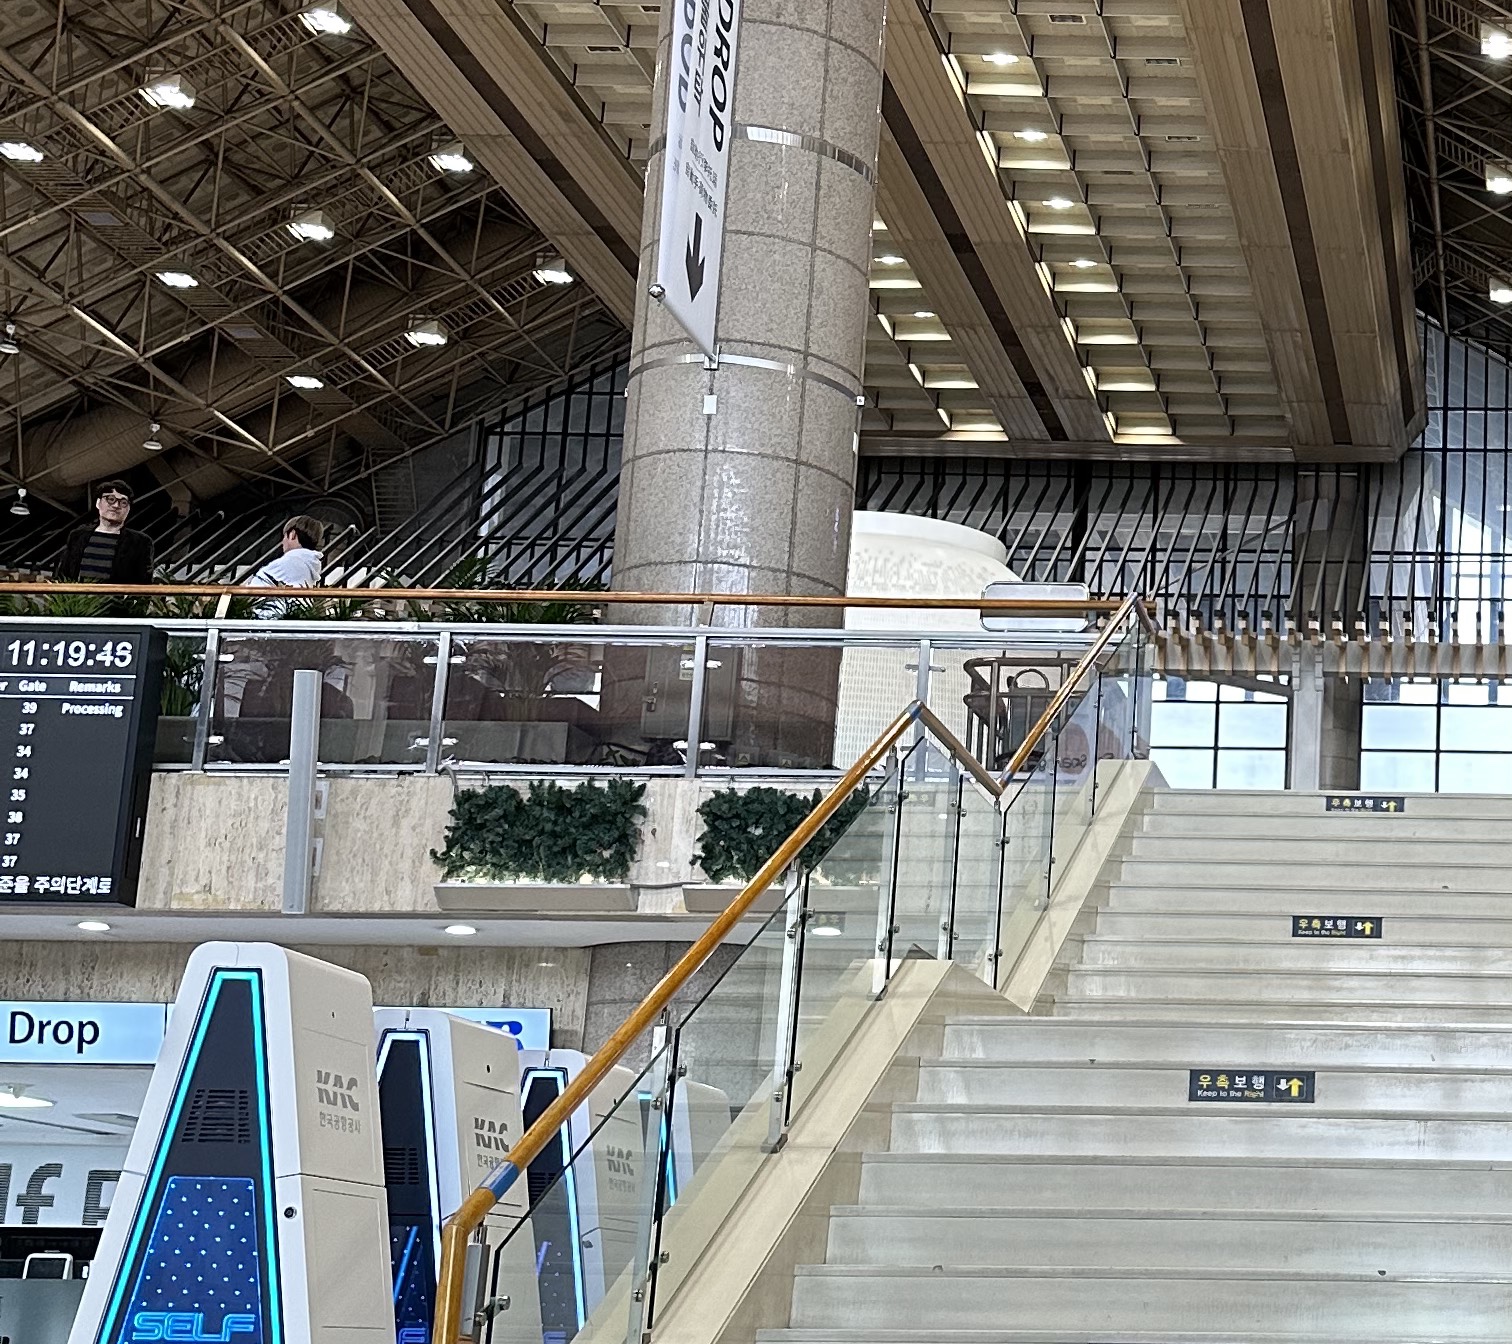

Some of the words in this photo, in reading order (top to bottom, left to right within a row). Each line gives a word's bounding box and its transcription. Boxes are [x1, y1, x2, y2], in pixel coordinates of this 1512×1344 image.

[18, 679, 47, 693] Gate
[69, 680, 122, 694] Remarks
[22, 701, 38, 714] 39
[61, 702, 125, 718] Processing
[19, 723, 35, 736] 37
[16, 745, 32, 758] 34
[13, 767, 29, 780] 34
[10, 789, 26, 801] 35
[5, 833, 21, 845] 37
[2, 855, 18, 868] 37
[34, 875, 113, 895] 주의단계로
[8, 1010, 101, 1055] Drop
[315, 1069, 360, 1112] KAC
[1197, 1089, 1218, 1098] Keep
[1219, 1089, 1228, 1097] to
[473, 1116, 510, 1153] KAC
[132, 1311, 256, 1343] SELF
